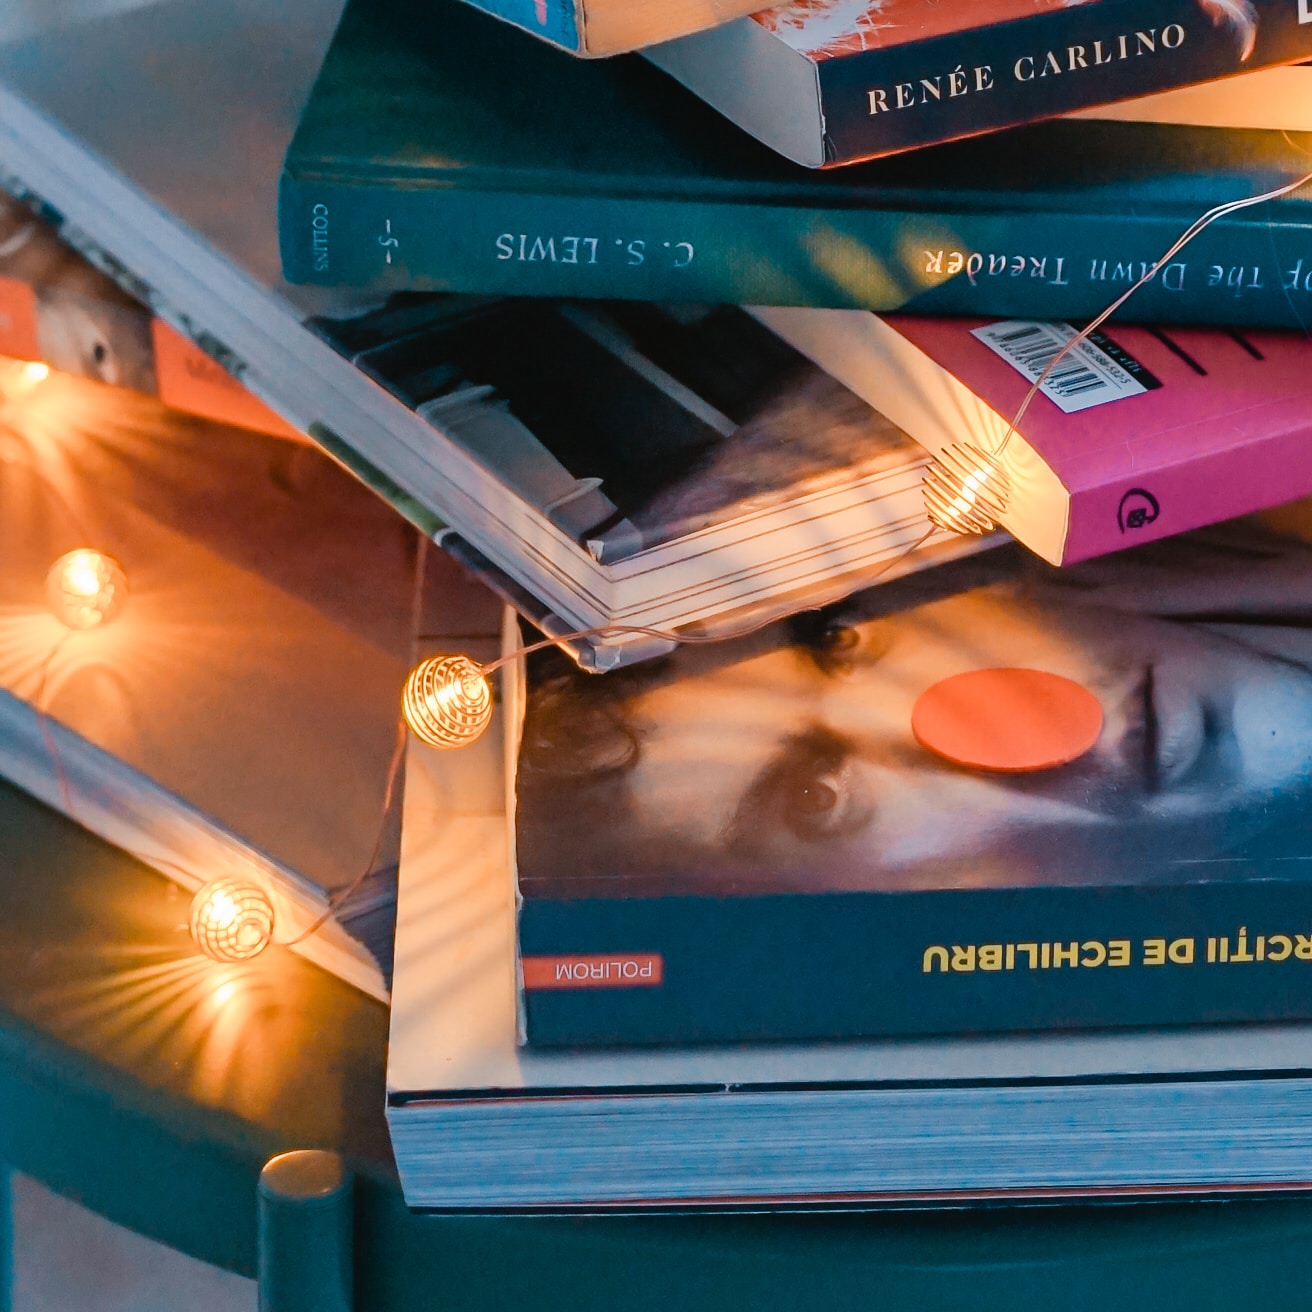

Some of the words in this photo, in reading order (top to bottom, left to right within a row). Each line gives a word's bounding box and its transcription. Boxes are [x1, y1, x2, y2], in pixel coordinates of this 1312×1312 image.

[867, 64, 994, 115] RENÉE
[1014, 24, 1186, 82] CARLINO
[312, 203, 329, 272] COLLINS
[496, 233, 599, 264] LEWIS
[614, 239, 646, 265] S.
[663, 242, 694, 267] C.
[1090, 258, 1187, 291] Dawn
[922, 940, 1131, 973] ECHILIBRU
[1143, 938, 1195, 965] DE
[555, 961, 652, 980] POLIROM
